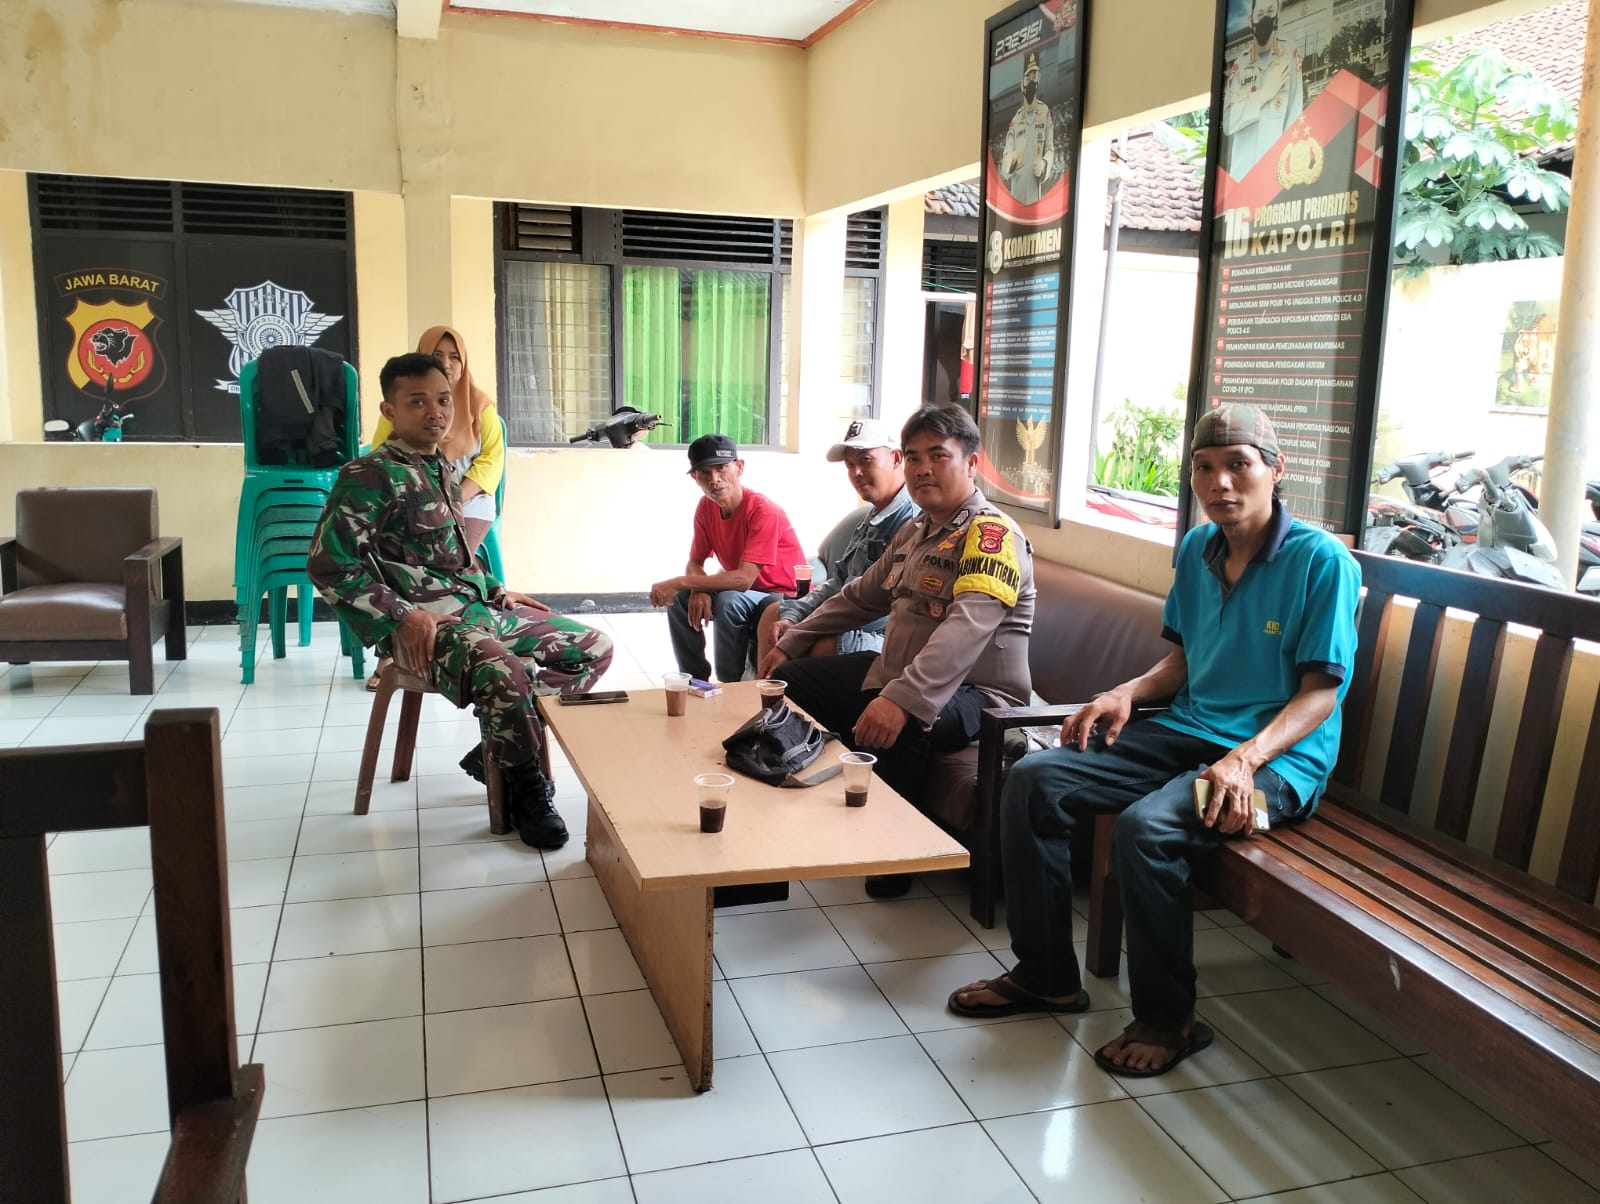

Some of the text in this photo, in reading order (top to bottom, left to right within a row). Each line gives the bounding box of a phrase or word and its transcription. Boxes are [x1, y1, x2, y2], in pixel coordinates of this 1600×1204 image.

[1253, 190, 1359, 229] PROGRAM PRIORITAS
[1003, 227, 1062, 260] KOMITMEN
[1223, 206, 1251, 260] 16
[1250, 219, 1357, 257] KAPOLRI
[988, 230, 1003, 274] 8
[65, 273, 160, 293] JAWA BARAT
[1273, 280, 1285, 290] DAN
[1284, 279, 1305, 289] METODE
[1305, 277, 1339, 288] ORGANISASI
[1321, 295, 1332, 304] ERA
[1352, 294, 1363, 303] 4.0
[1309, 314, 1334, 323] MODERN
[1340, 313, 1352, 322] ERA
[922, 553, 955, 571] POLRI
